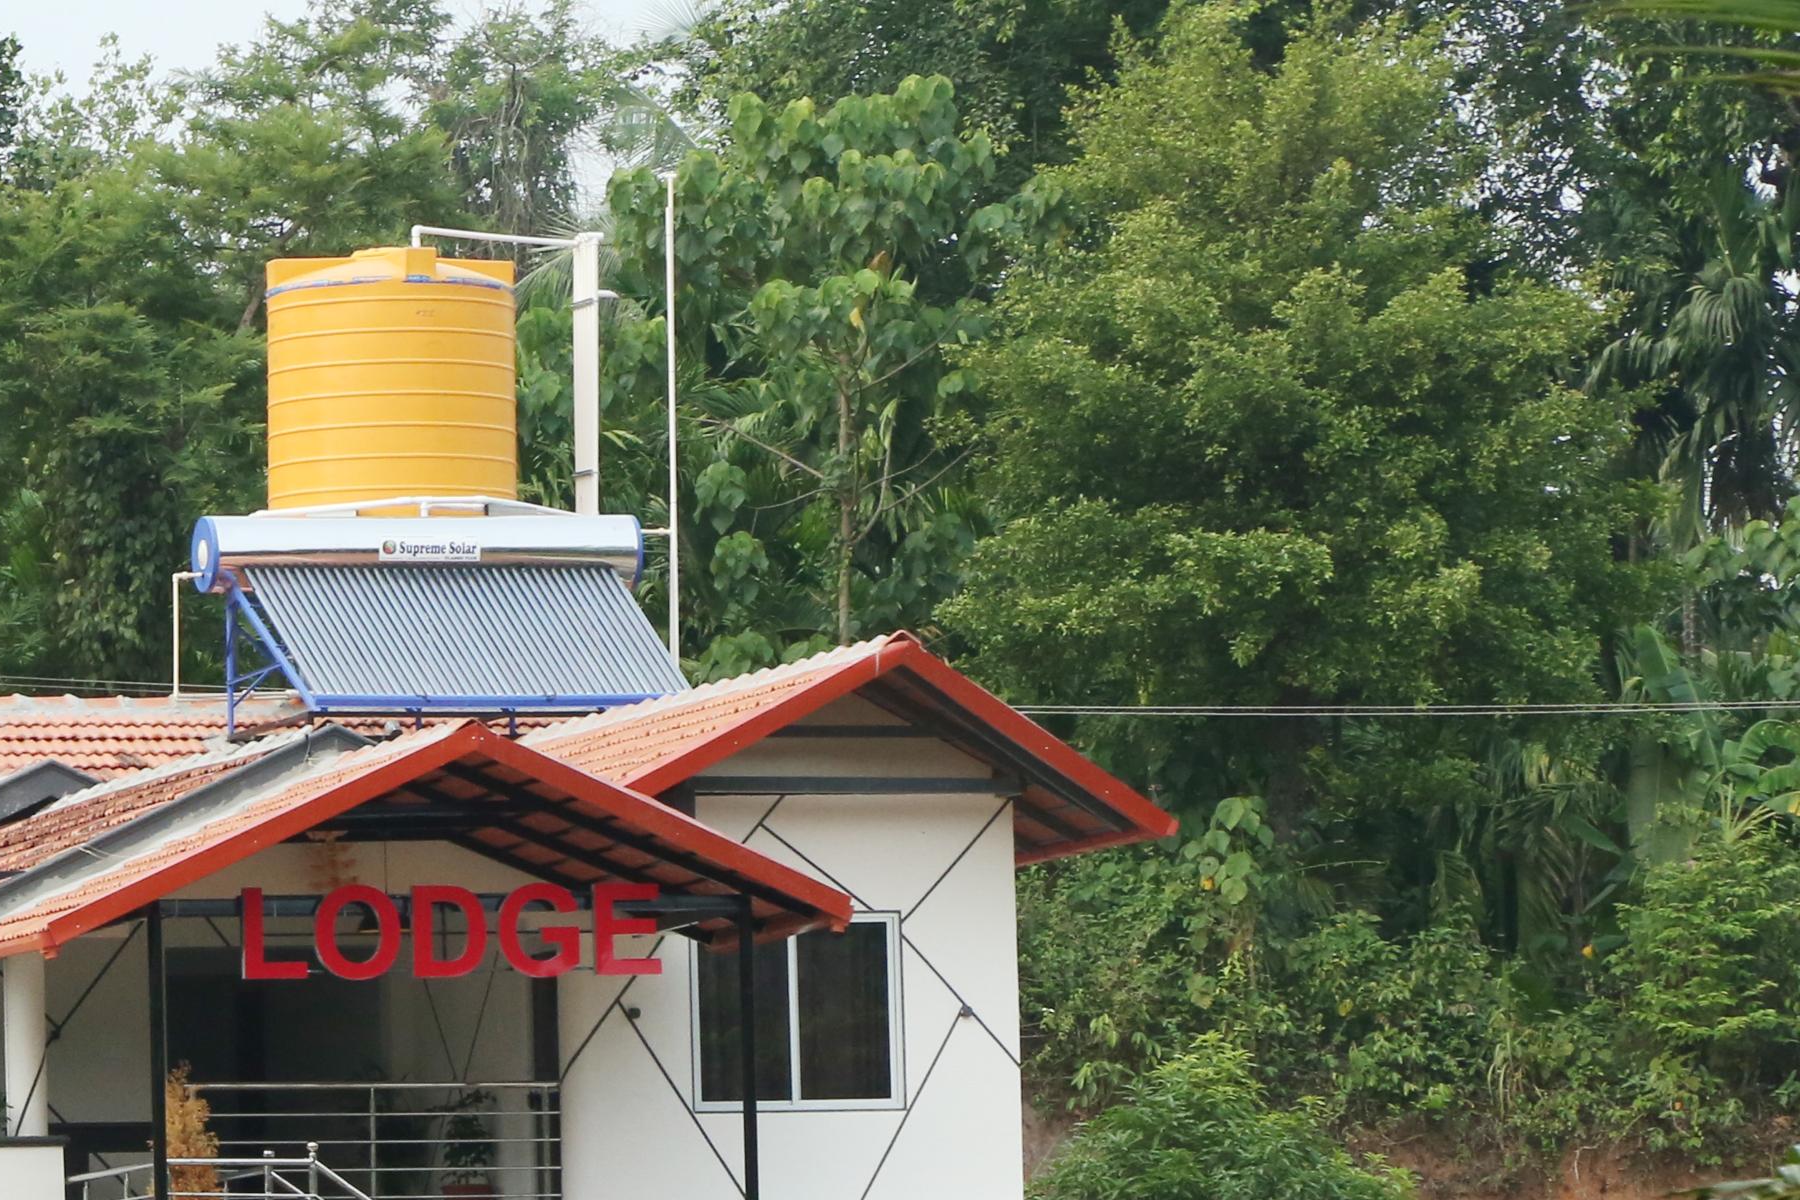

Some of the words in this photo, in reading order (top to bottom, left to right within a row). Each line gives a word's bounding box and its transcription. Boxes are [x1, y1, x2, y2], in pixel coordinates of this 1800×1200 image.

[399, 541, 447, 557] Supreme
[449, 541, 477, 554] Solar
[241, 882, 663, 981] LODGE
